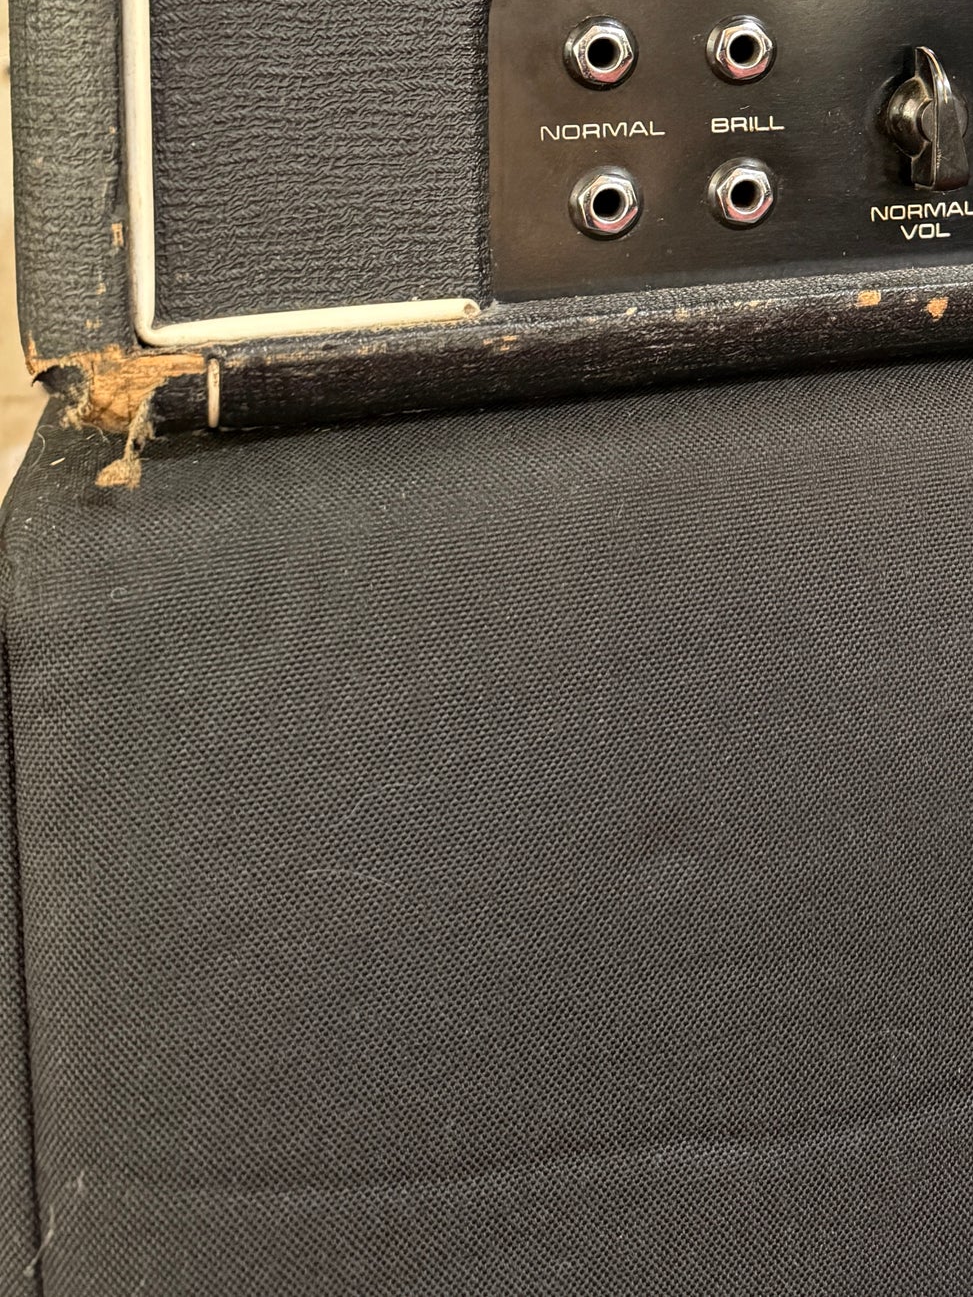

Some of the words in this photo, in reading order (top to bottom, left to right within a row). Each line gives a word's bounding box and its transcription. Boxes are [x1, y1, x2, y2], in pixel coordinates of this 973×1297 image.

[540, 120, 666, 141] NORMAL
[711, 115, 785, 134] BRILL
[900, 222, 951, 241] VOL
